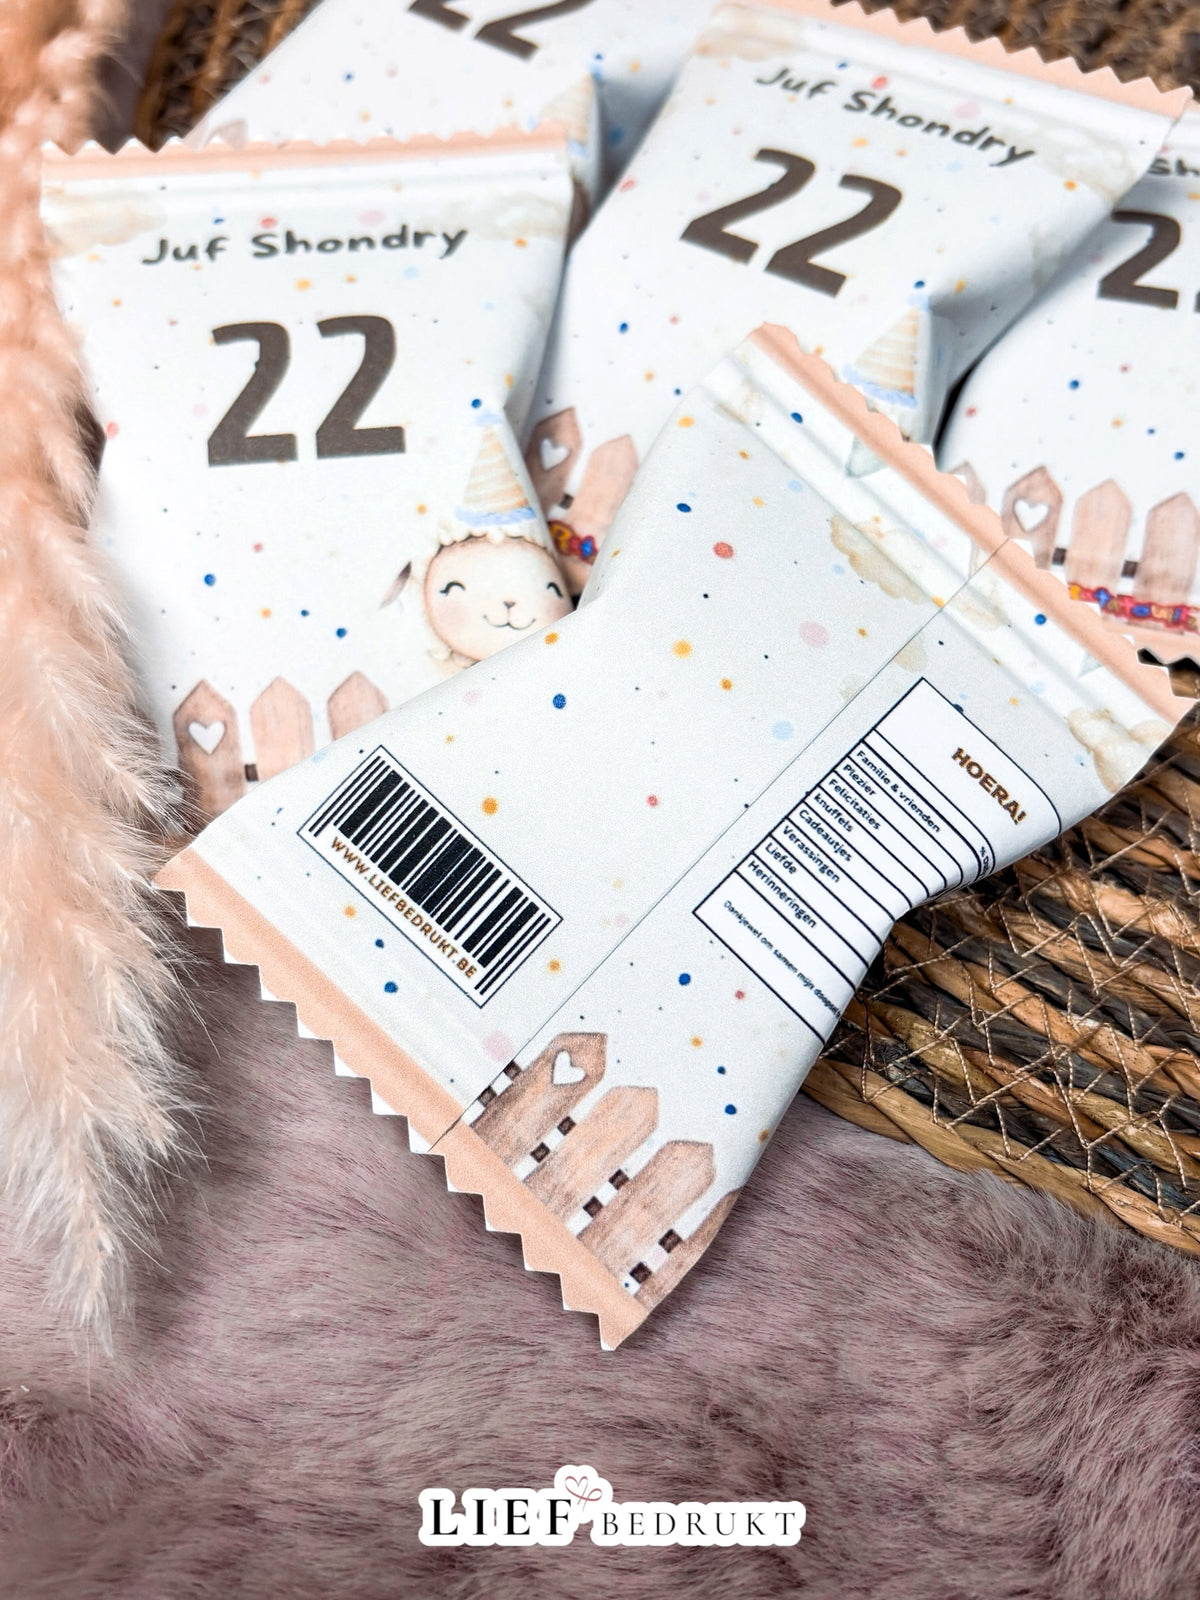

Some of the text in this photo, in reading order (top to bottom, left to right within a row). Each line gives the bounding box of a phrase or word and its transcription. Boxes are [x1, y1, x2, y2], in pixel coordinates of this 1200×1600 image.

[755, 67, 1037, 168] Juf Shondry
[141, 224, 468, 266] Juf Shondry
[680, 147, 904, 298] 22
[207, 314, 407, 468] 22
[829, 779, 880, 829] Felicitaties
[843, 764, 875, 795] Plezier
[857, 751, 940, 832] Familie & vrienden
[952, 748, 1026, 825] HOERA!
[765, 843, 796, 874] Liefde
[784, 826, 839, 882] Verassingen
[800, 810, 851, 861] Cadeautjes
[330, 836, 479, 978] WWW.LIEFBEDRUKT.BE
[748, 861, 816, 927] Herinneringen
[761, 938, 773, 949] om
[774, 950, 798, 973] samen
